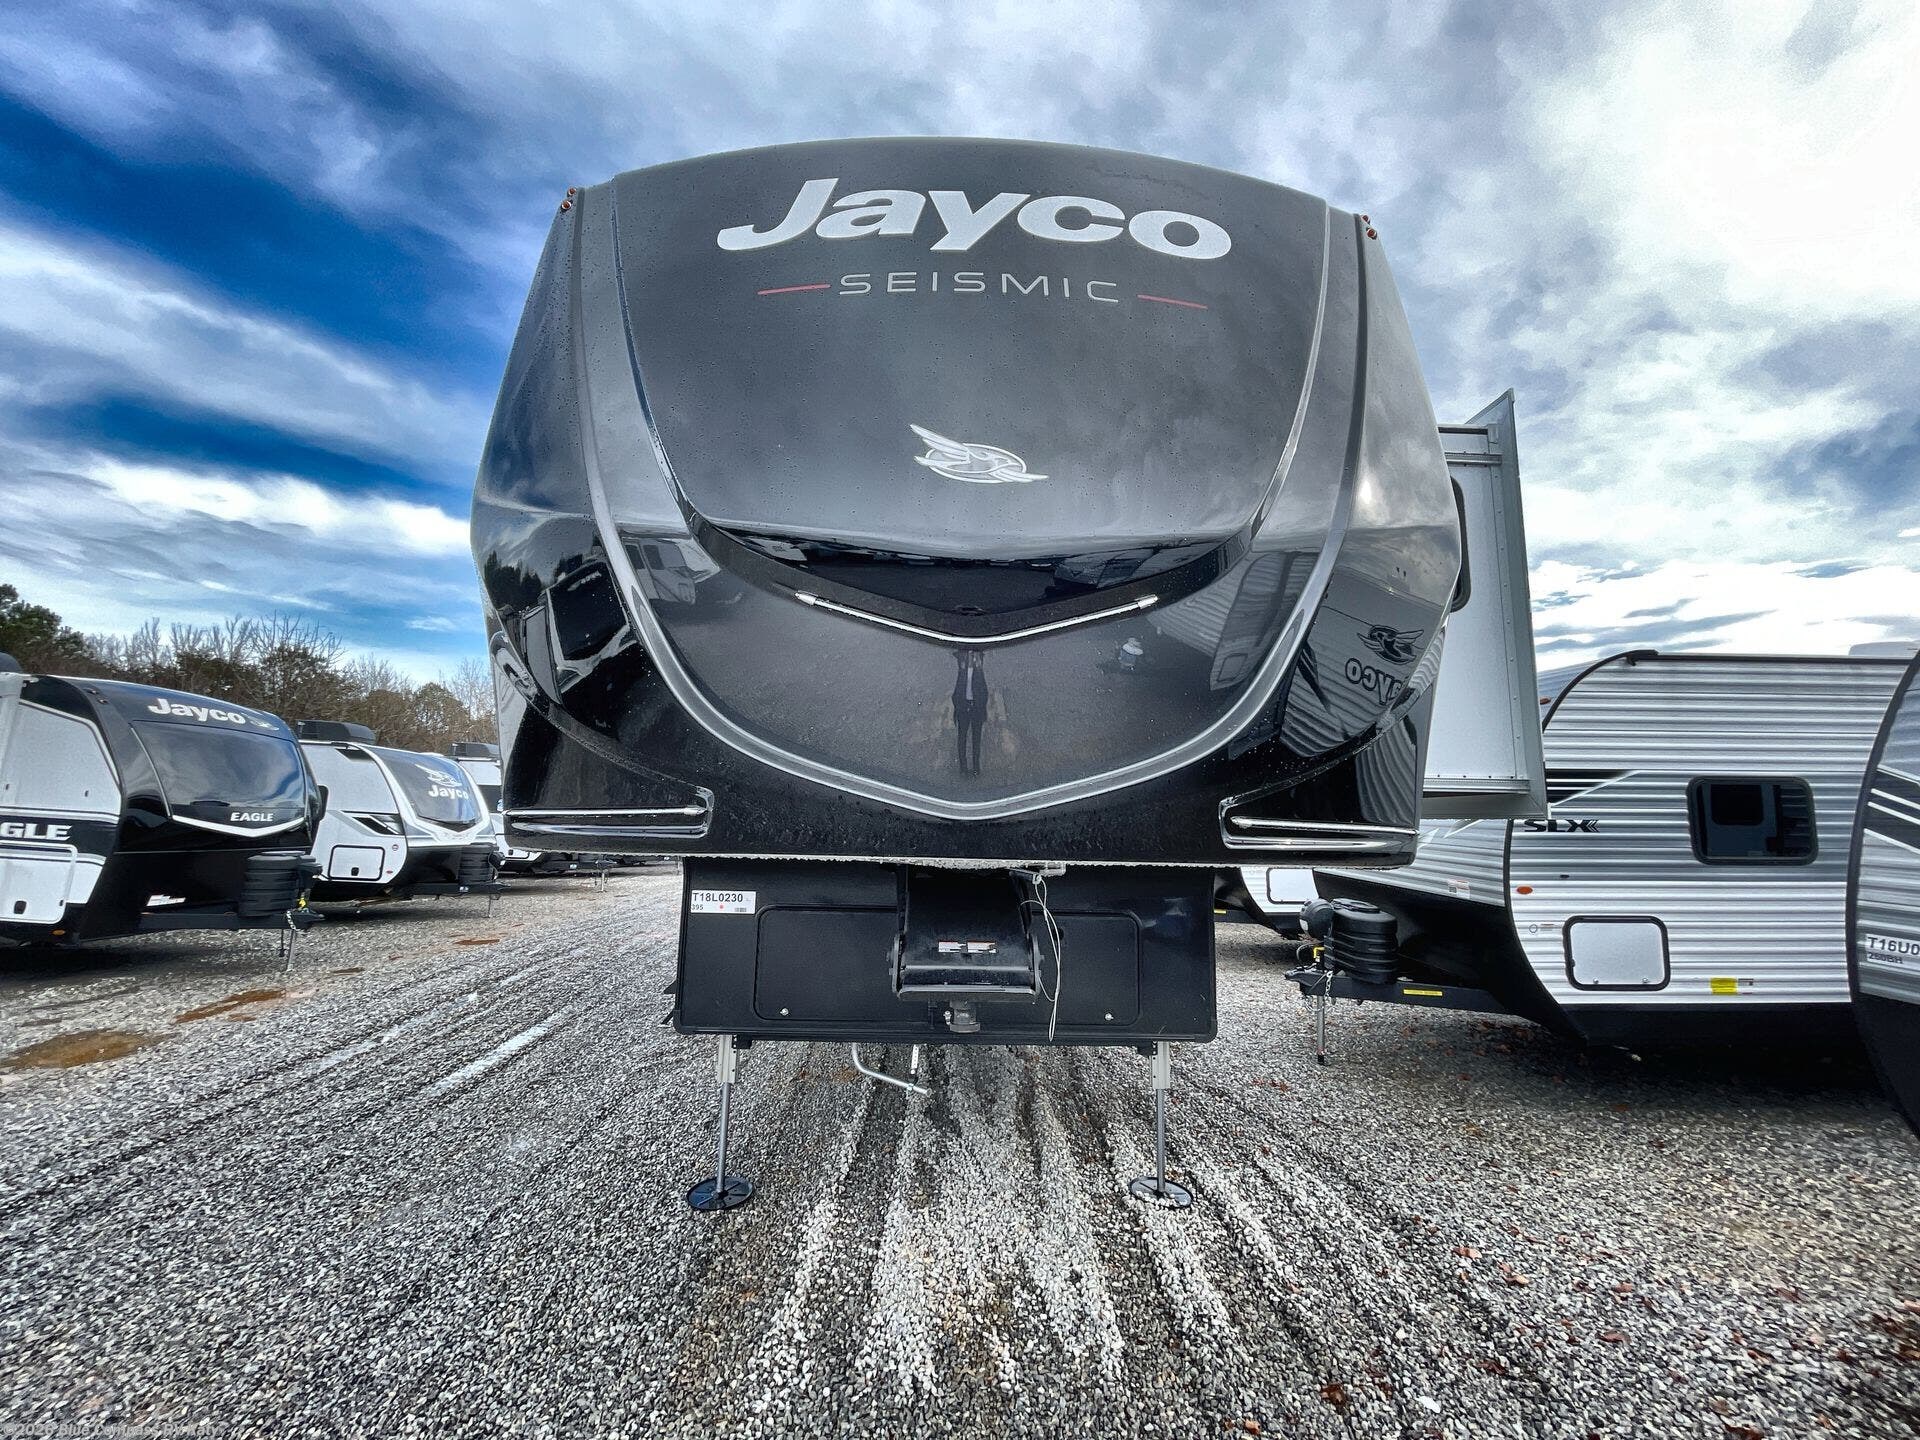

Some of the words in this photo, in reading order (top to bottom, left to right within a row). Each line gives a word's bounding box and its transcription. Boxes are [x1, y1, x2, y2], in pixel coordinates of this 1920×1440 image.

[717, 178, 1232, 259] Jayco
[839, 271, 1119, 303] SEISMIC
[147, 698, 246, 724] Jayco
[428, 784, 469, 799] Jayco
[230, 812, 274, 822] EAGLE
[692, 892, 743, 902] T18L0230
